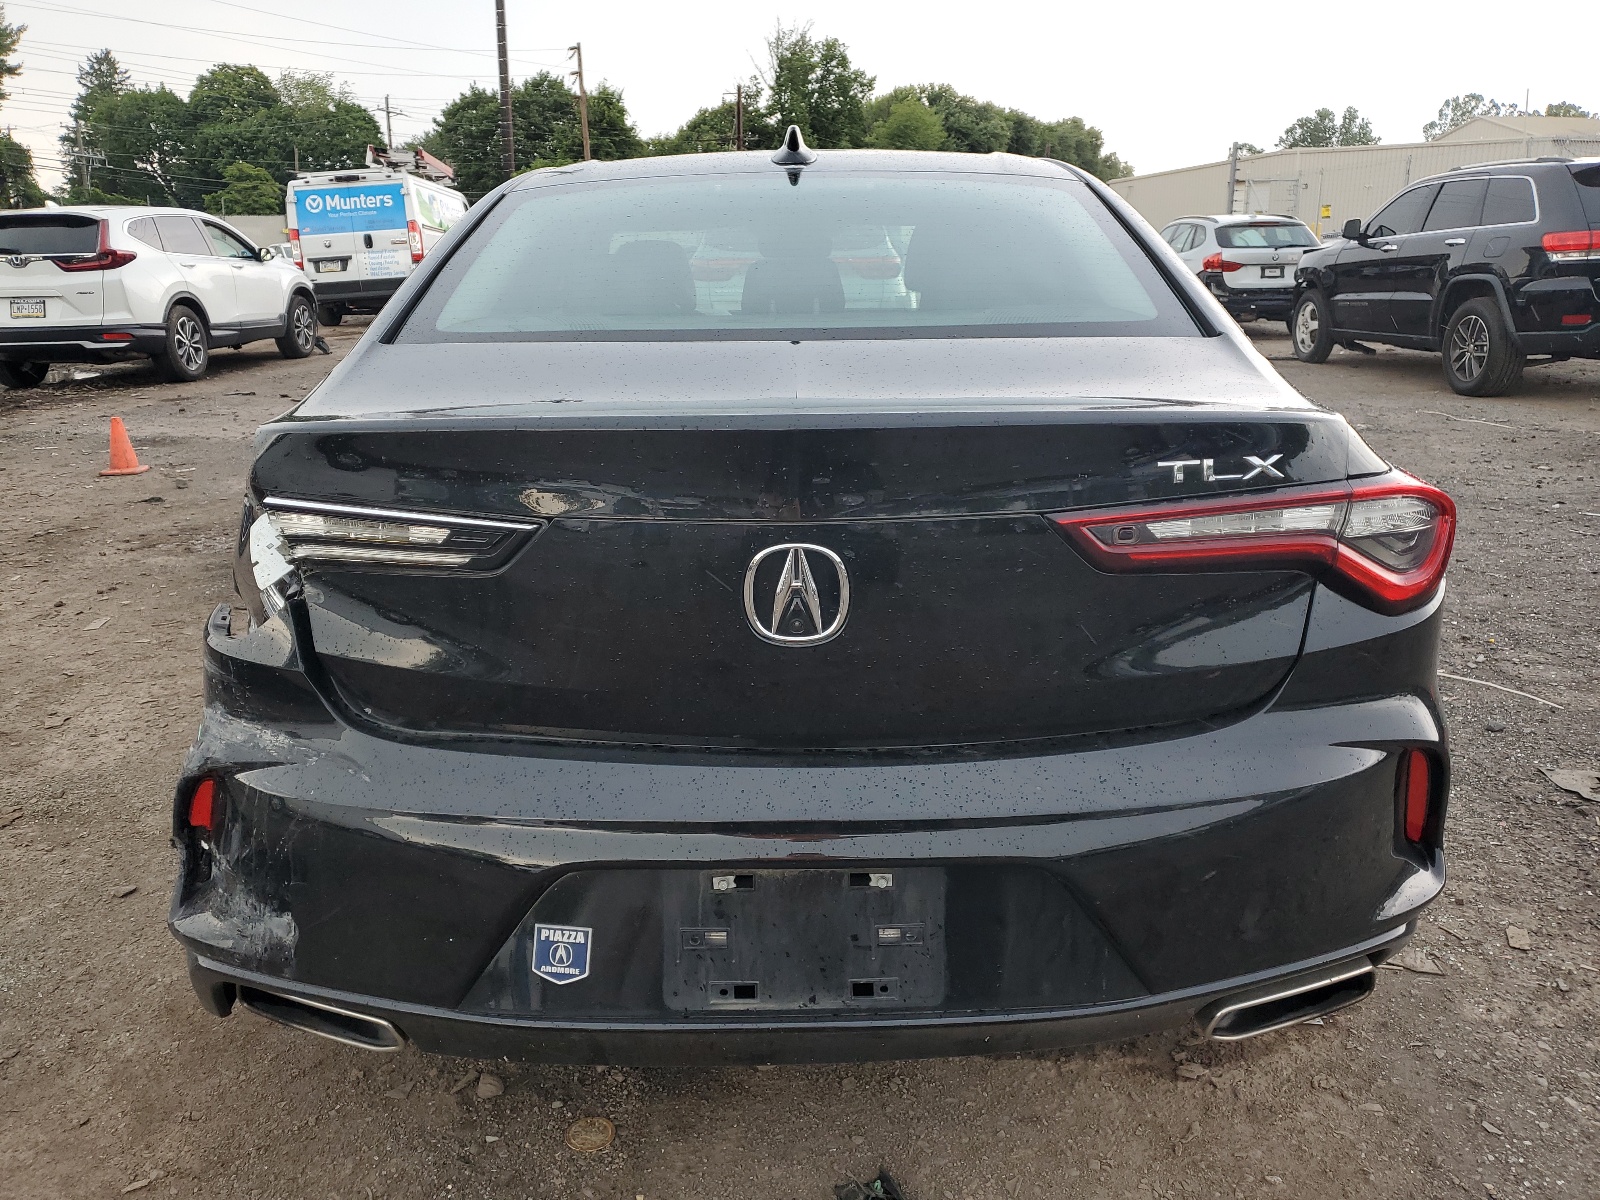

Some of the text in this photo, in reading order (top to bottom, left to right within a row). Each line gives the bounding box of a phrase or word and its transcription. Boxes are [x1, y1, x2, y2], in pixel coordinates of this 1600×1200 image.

[325, 194, 393, 211] Munters
[1157, 453, 1285, 484] TLX
[540, 928, 585, 944] PIAZZA
[540, 965, 581, 975] ARDMORE
